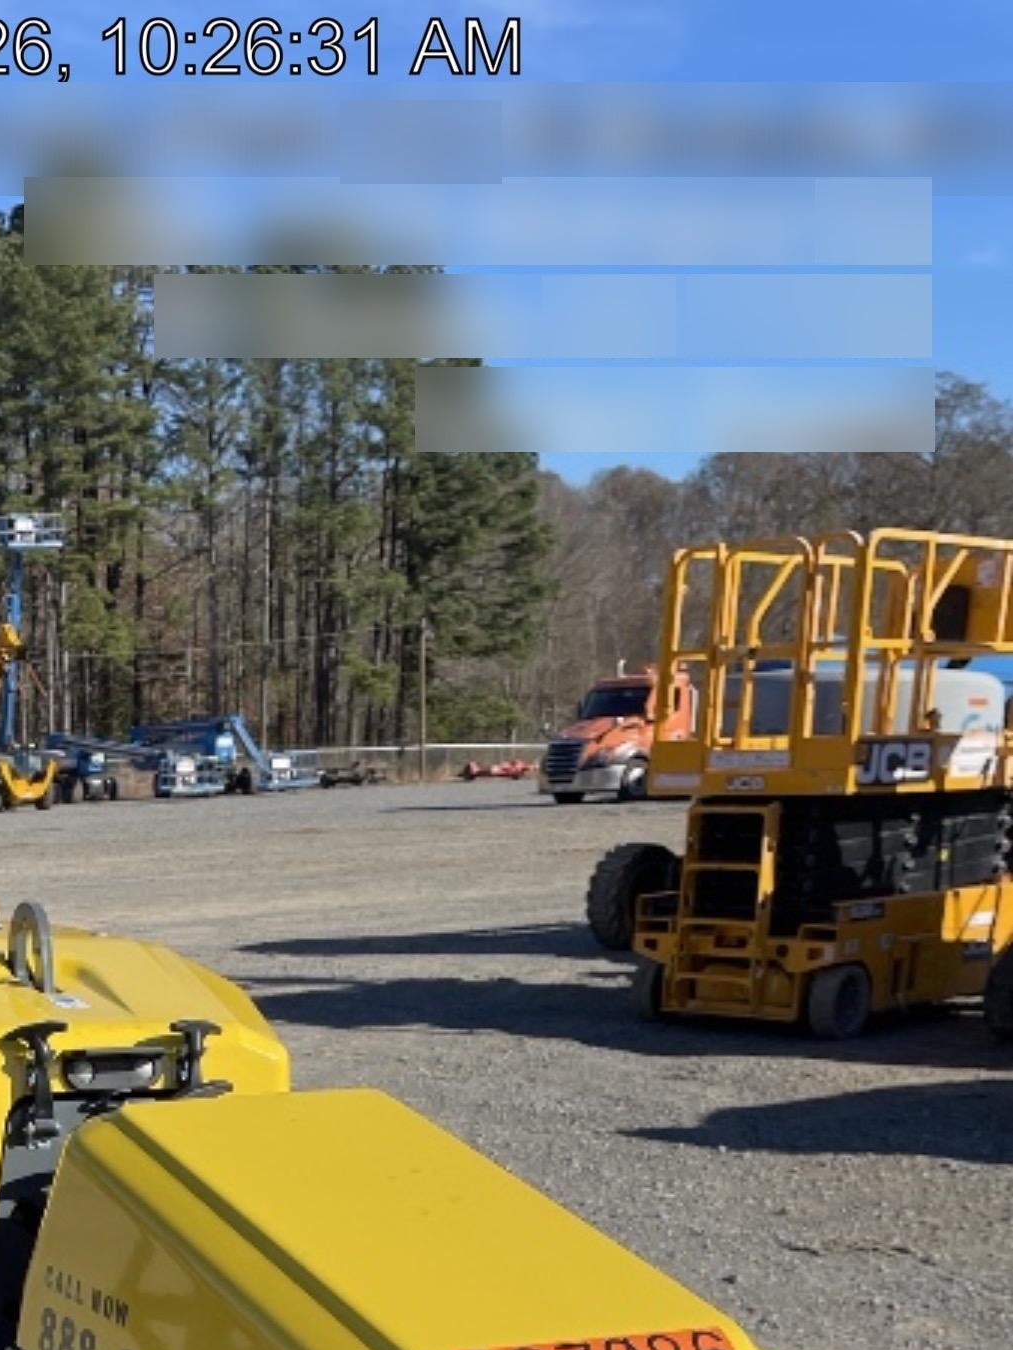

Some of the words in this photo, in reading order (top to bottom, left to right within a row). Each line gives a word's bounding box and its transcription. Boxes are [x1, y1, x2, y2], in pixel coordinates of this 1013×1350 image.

[858, 743, 931, 785] JCB
[44, 1264, 84, 1306] CALL
[91, 1287, 129, 1328] NOW
